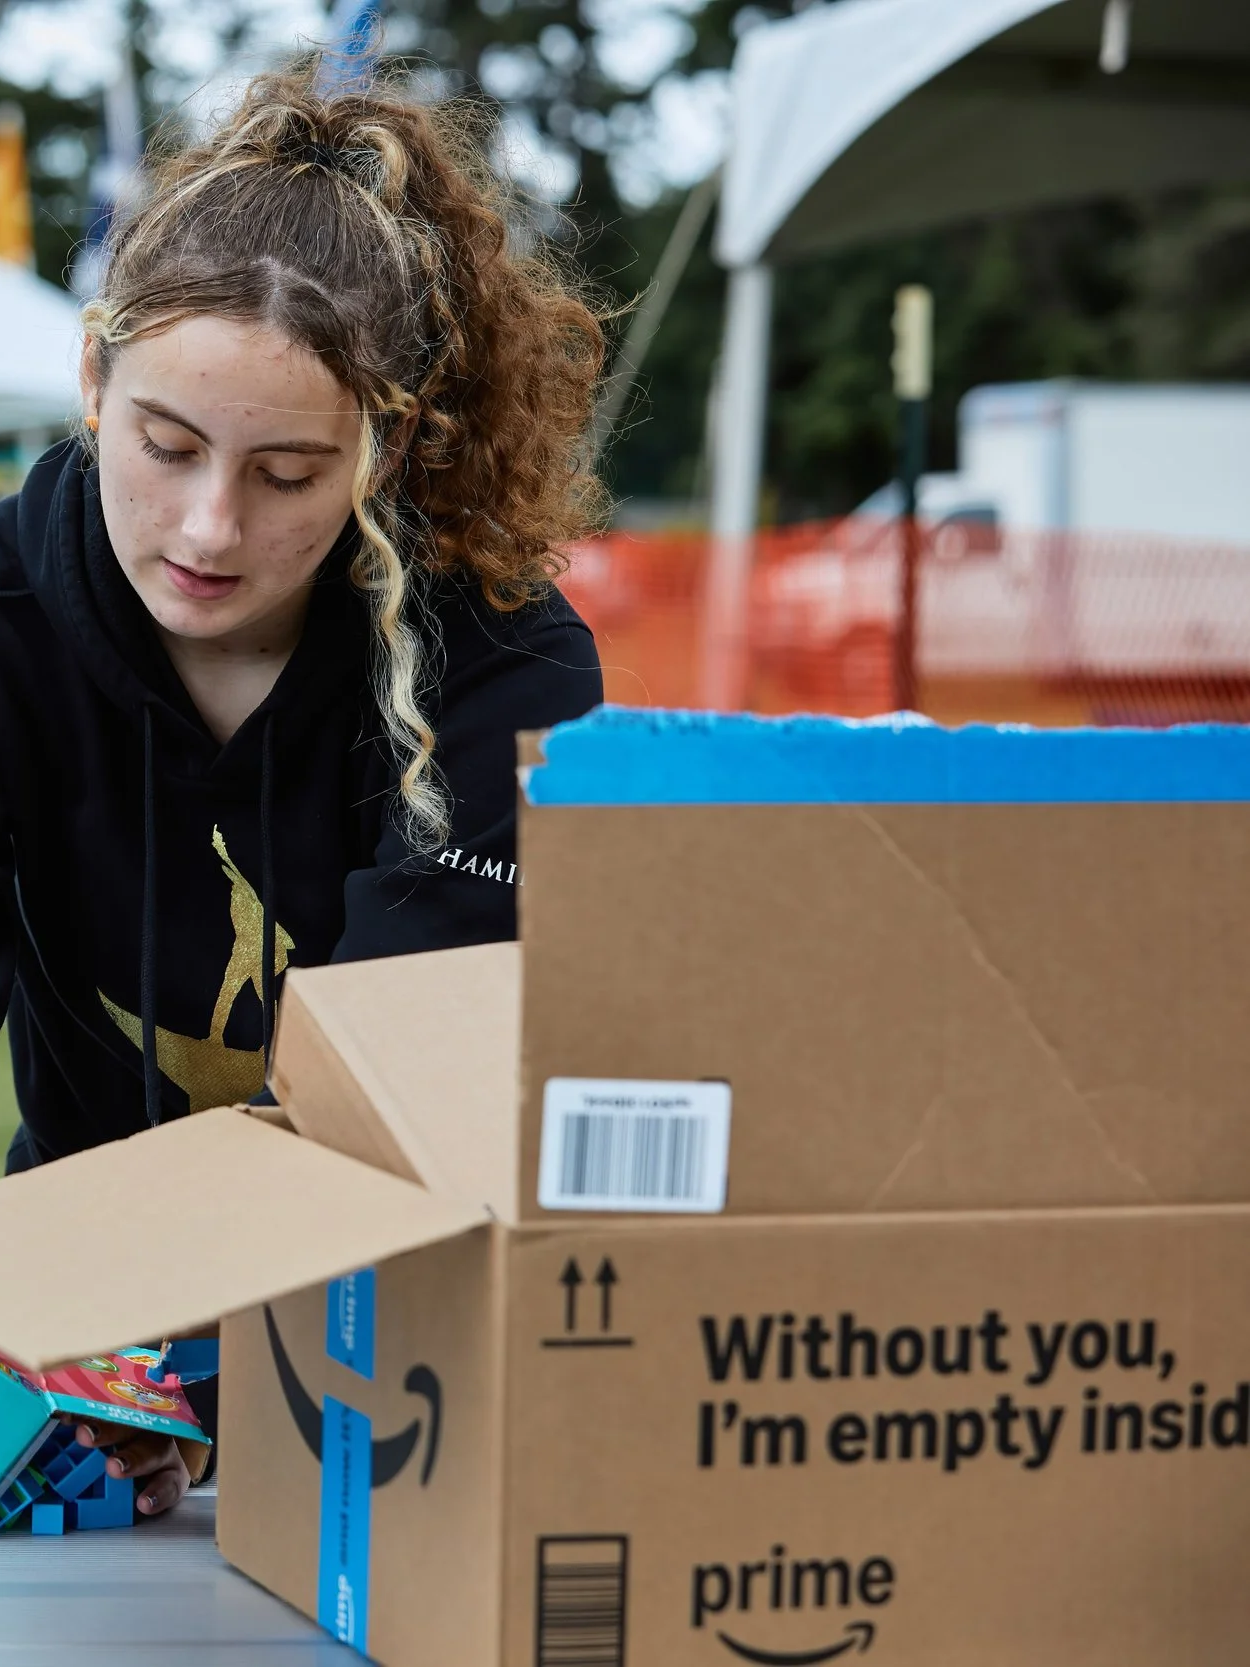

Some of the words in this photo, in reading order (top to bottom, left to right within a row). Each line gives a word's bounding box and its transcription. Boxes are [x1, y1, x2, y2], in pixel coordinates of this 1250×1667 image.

[699, 1310, 1010, 1383] Without
[1025, 1318, 1176, 1387] you,
[698, 1400, 807, 1468] I'm
[827, 1395, 1066, 1473] empty
[690, 1543, 896, 1630] prime
